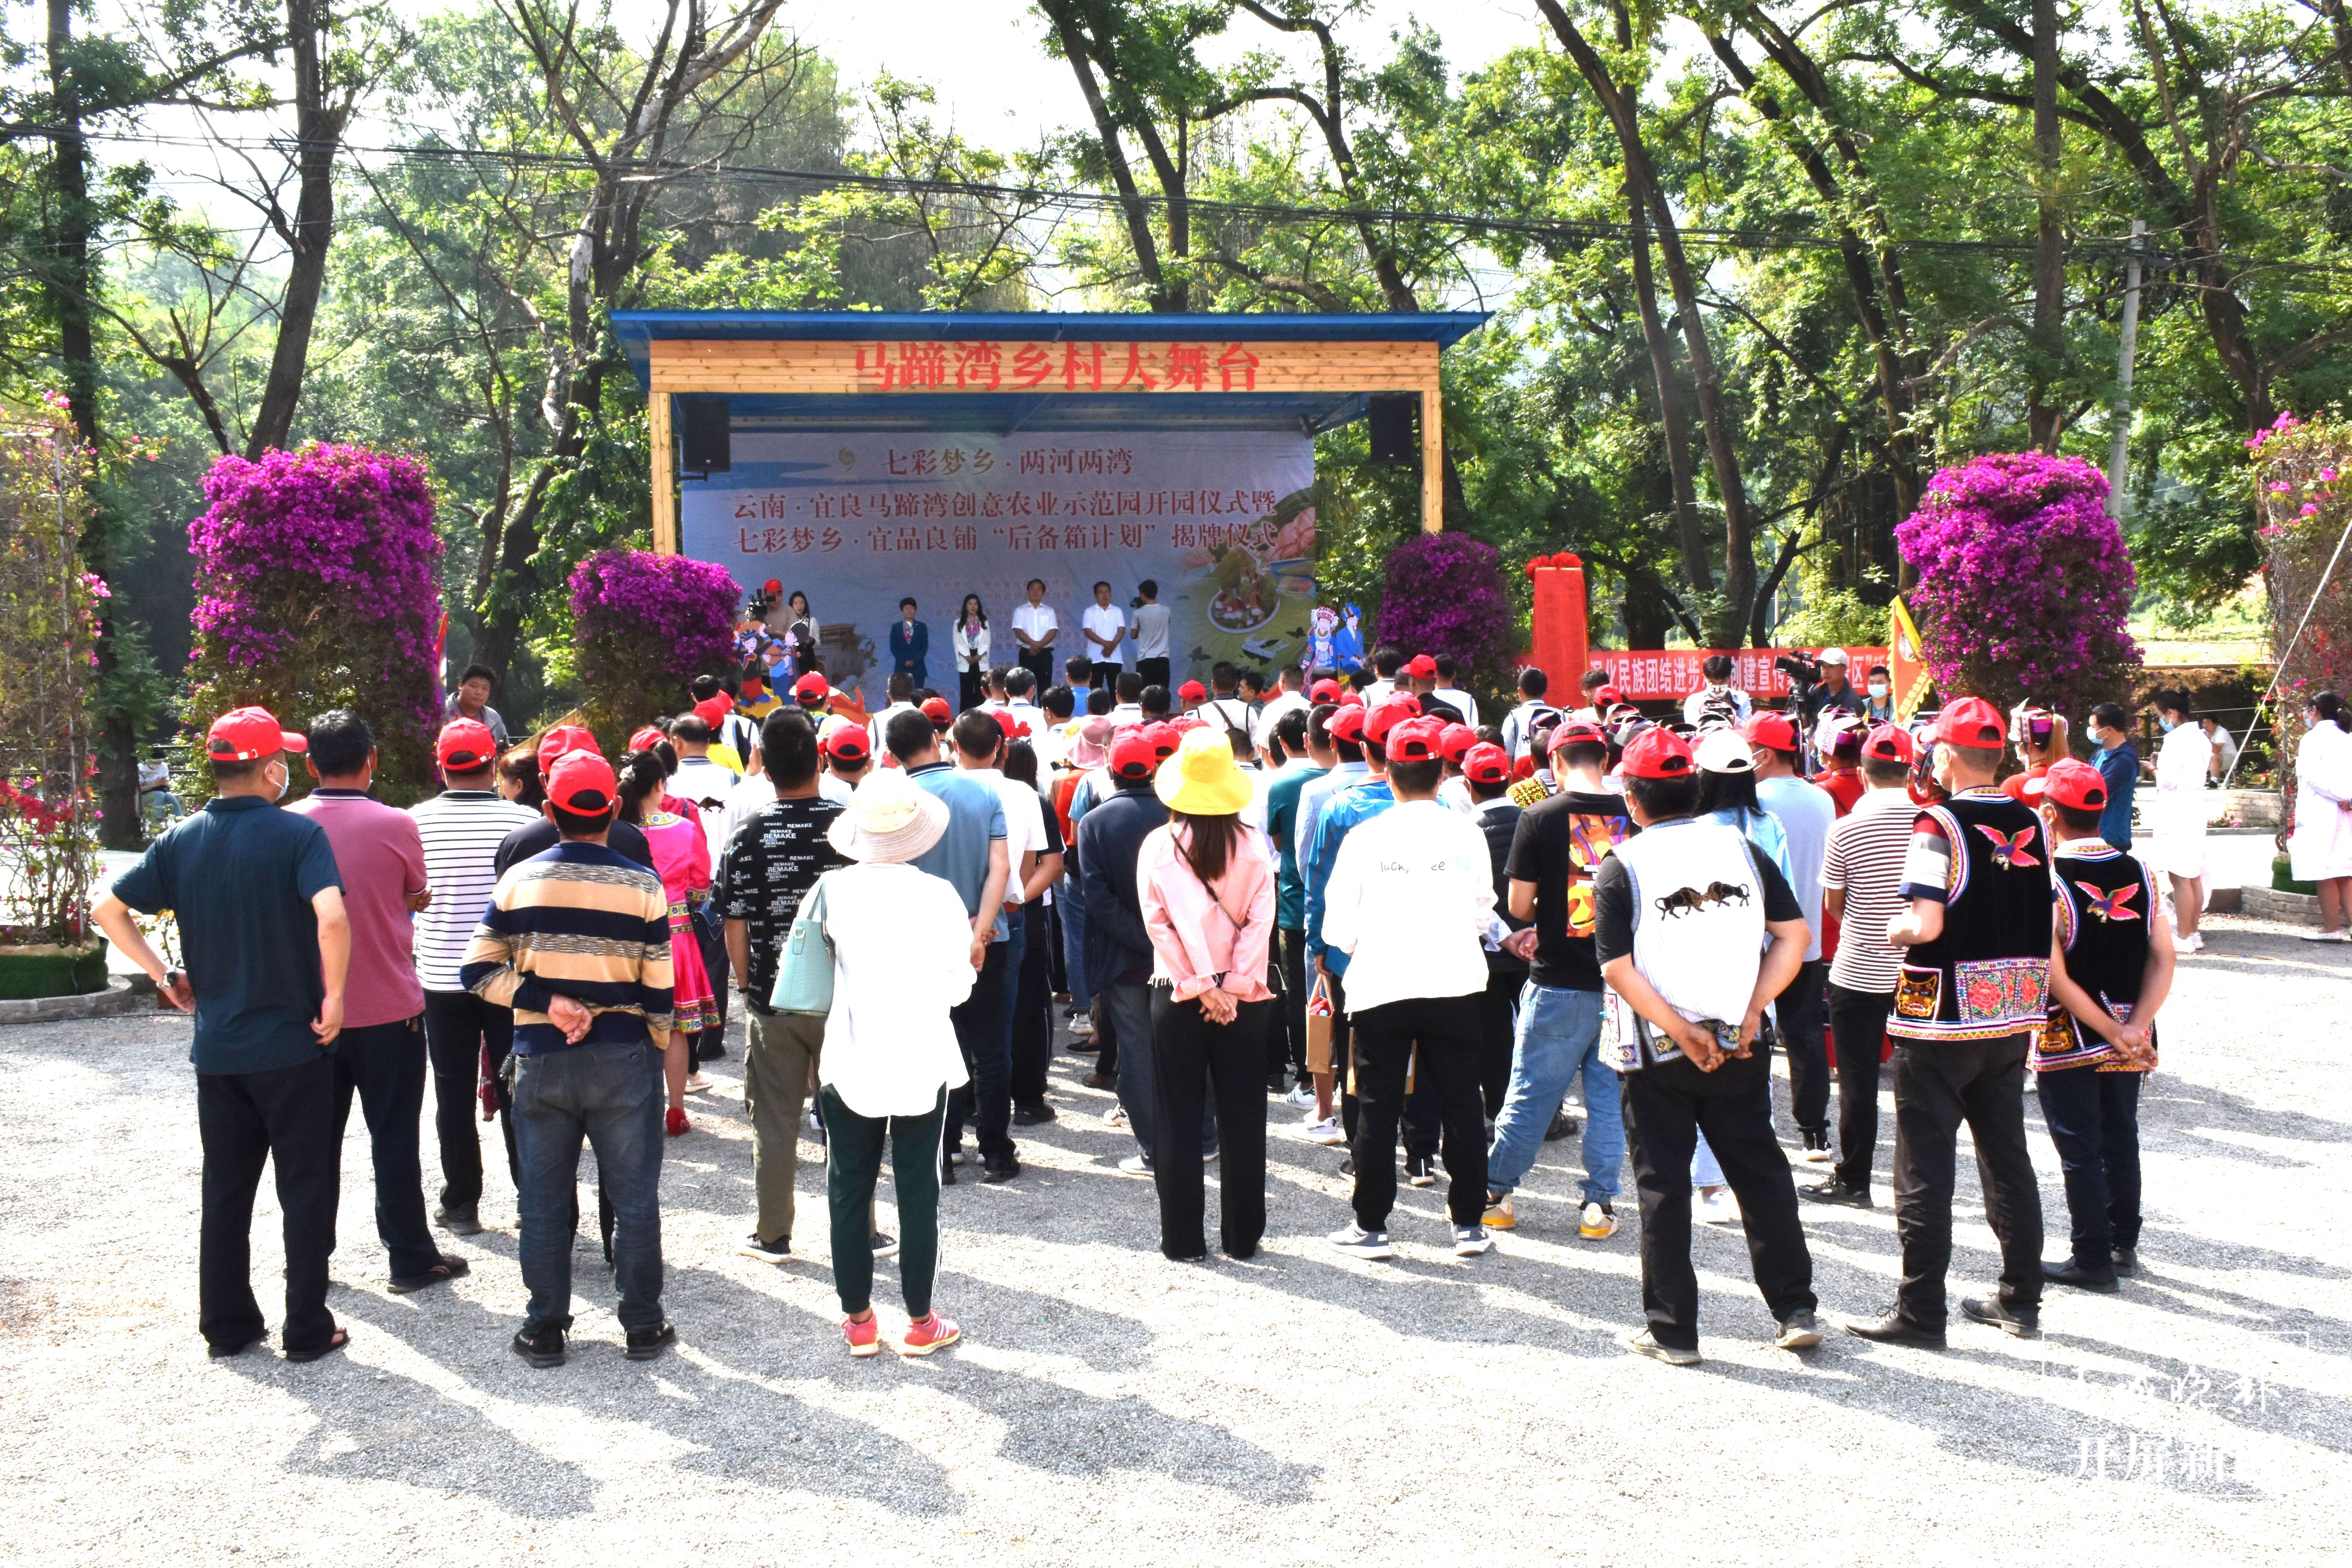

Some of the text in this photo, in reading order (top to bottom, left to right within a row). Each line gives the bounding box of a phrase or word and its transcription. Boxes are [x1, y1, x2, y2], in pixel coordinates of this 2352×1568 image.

[847, 340, 1259, 391] 马蹄湾乡村大舞台
[882, 448, 1132, 475] 七彩梦乡·两河两湾
